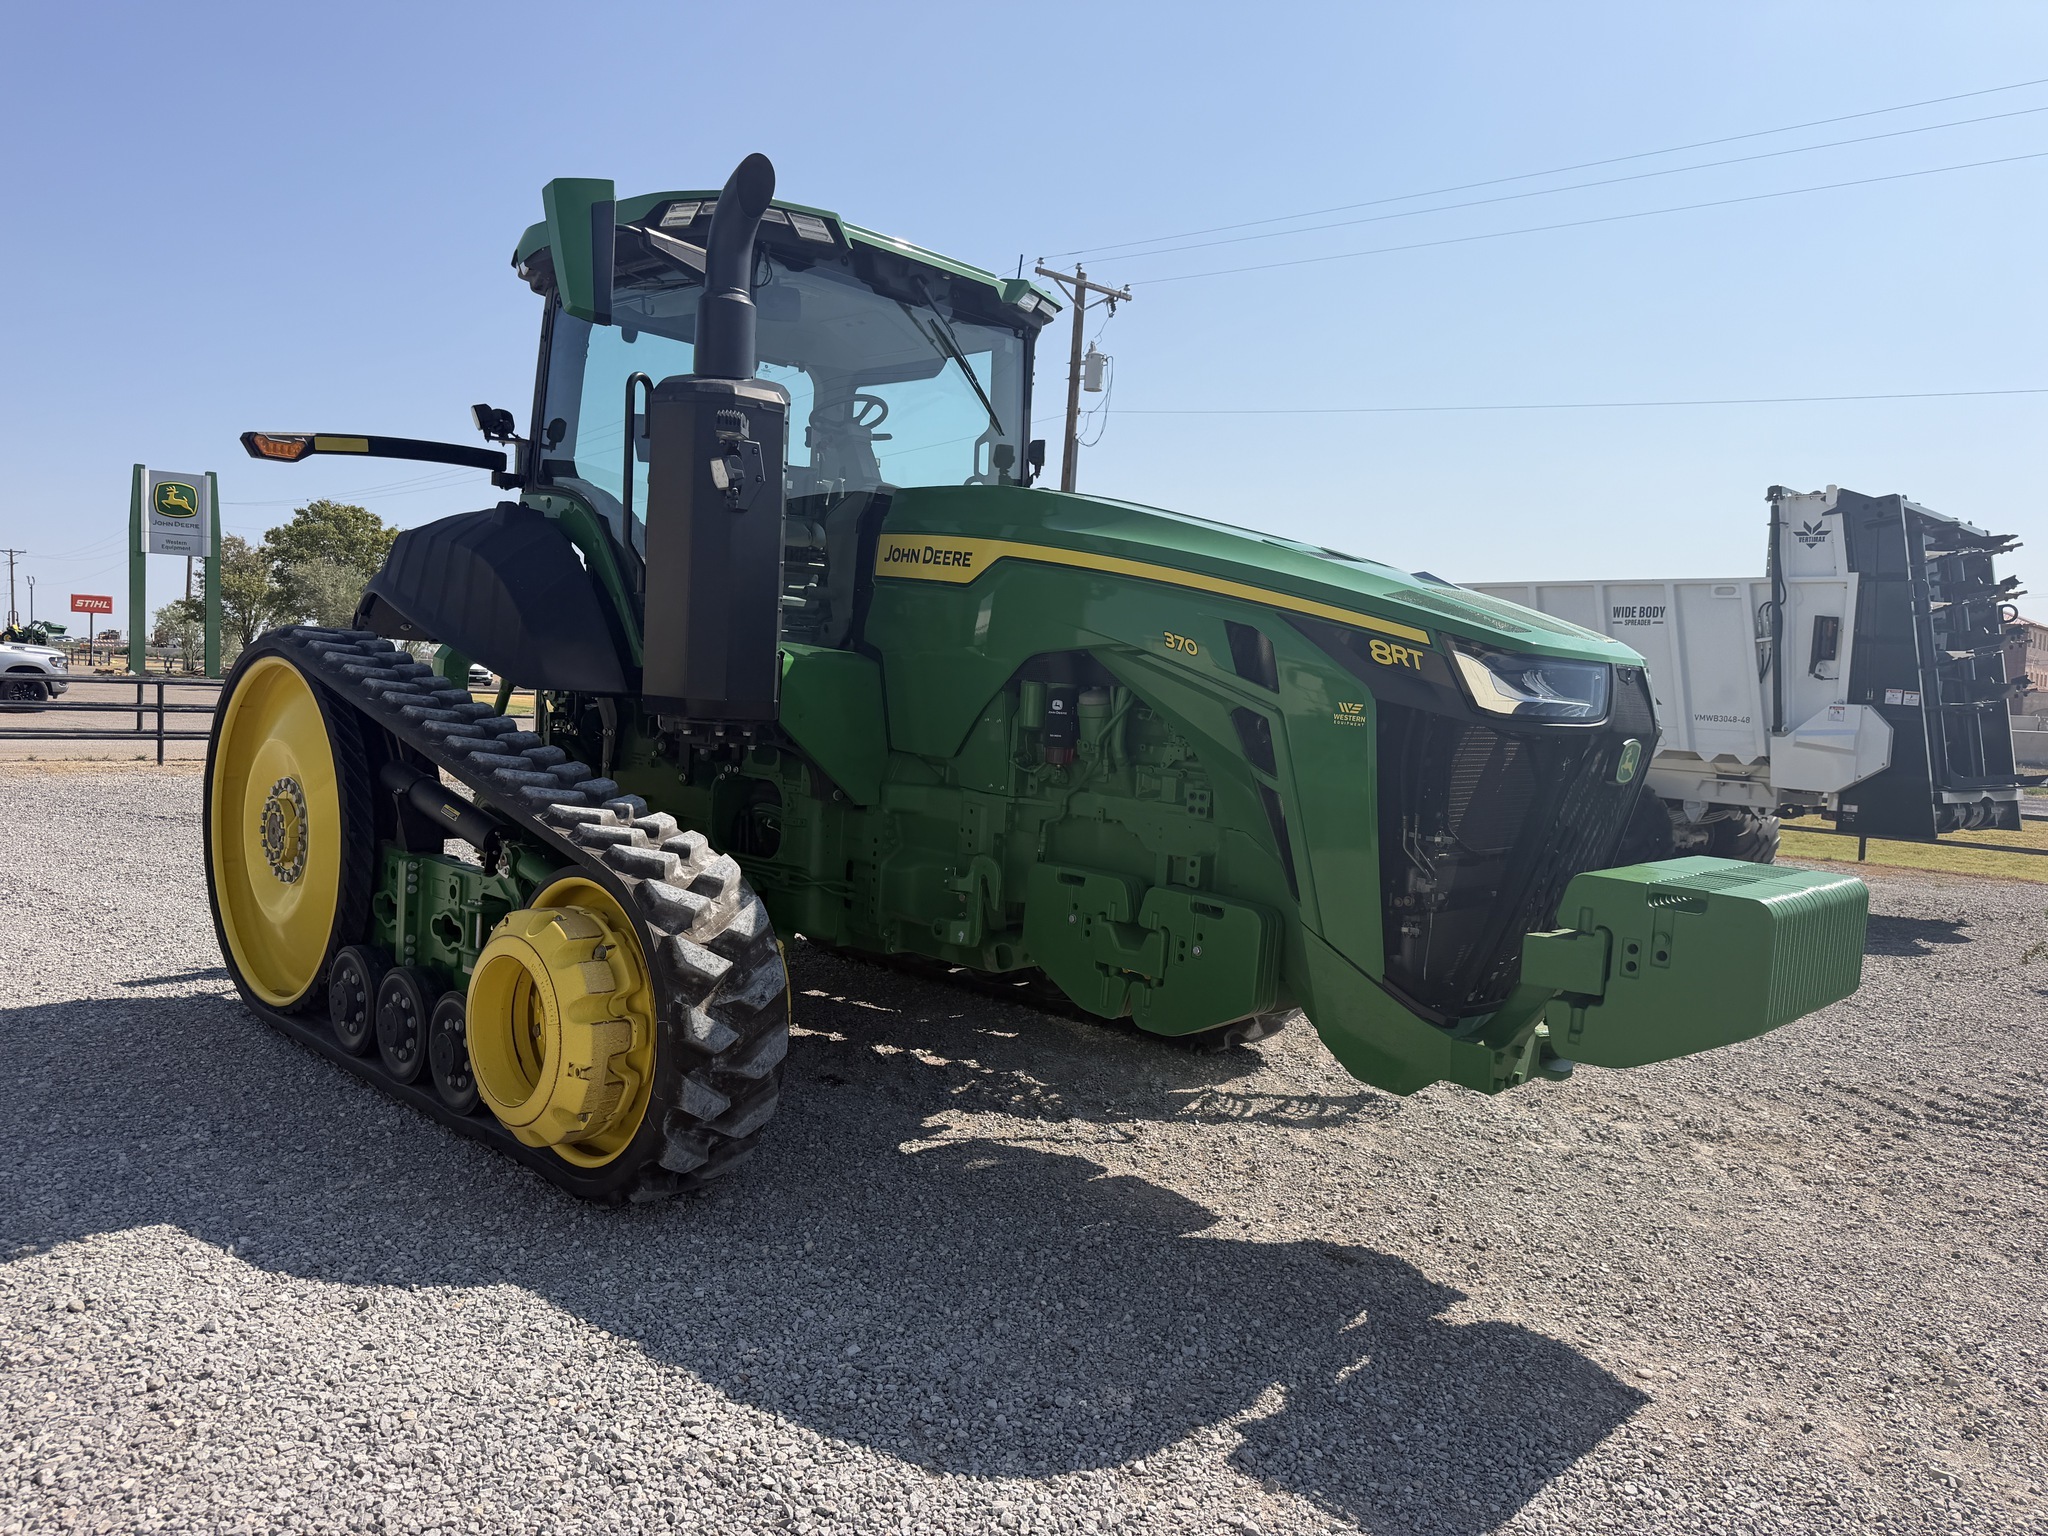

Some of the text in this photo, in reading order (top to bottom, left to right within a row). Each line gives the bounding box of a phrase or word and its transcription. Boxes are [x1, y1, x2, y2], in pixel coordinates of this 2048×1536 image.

[174, 521, 200, 529] DEERE
[884, 544, 973, 567] JOHN DEERE
[75, 600, 110, 609] STIHL
[1612, 606, 1666, 618] WIDE BODY
[1163, 631, 1198, 656] 370
[1368, 639, 1424, 671] 8RT
[1333, 713, 1366, 722] WESTERN
[1694, 714, 1751, 724] VMWB3048-48
